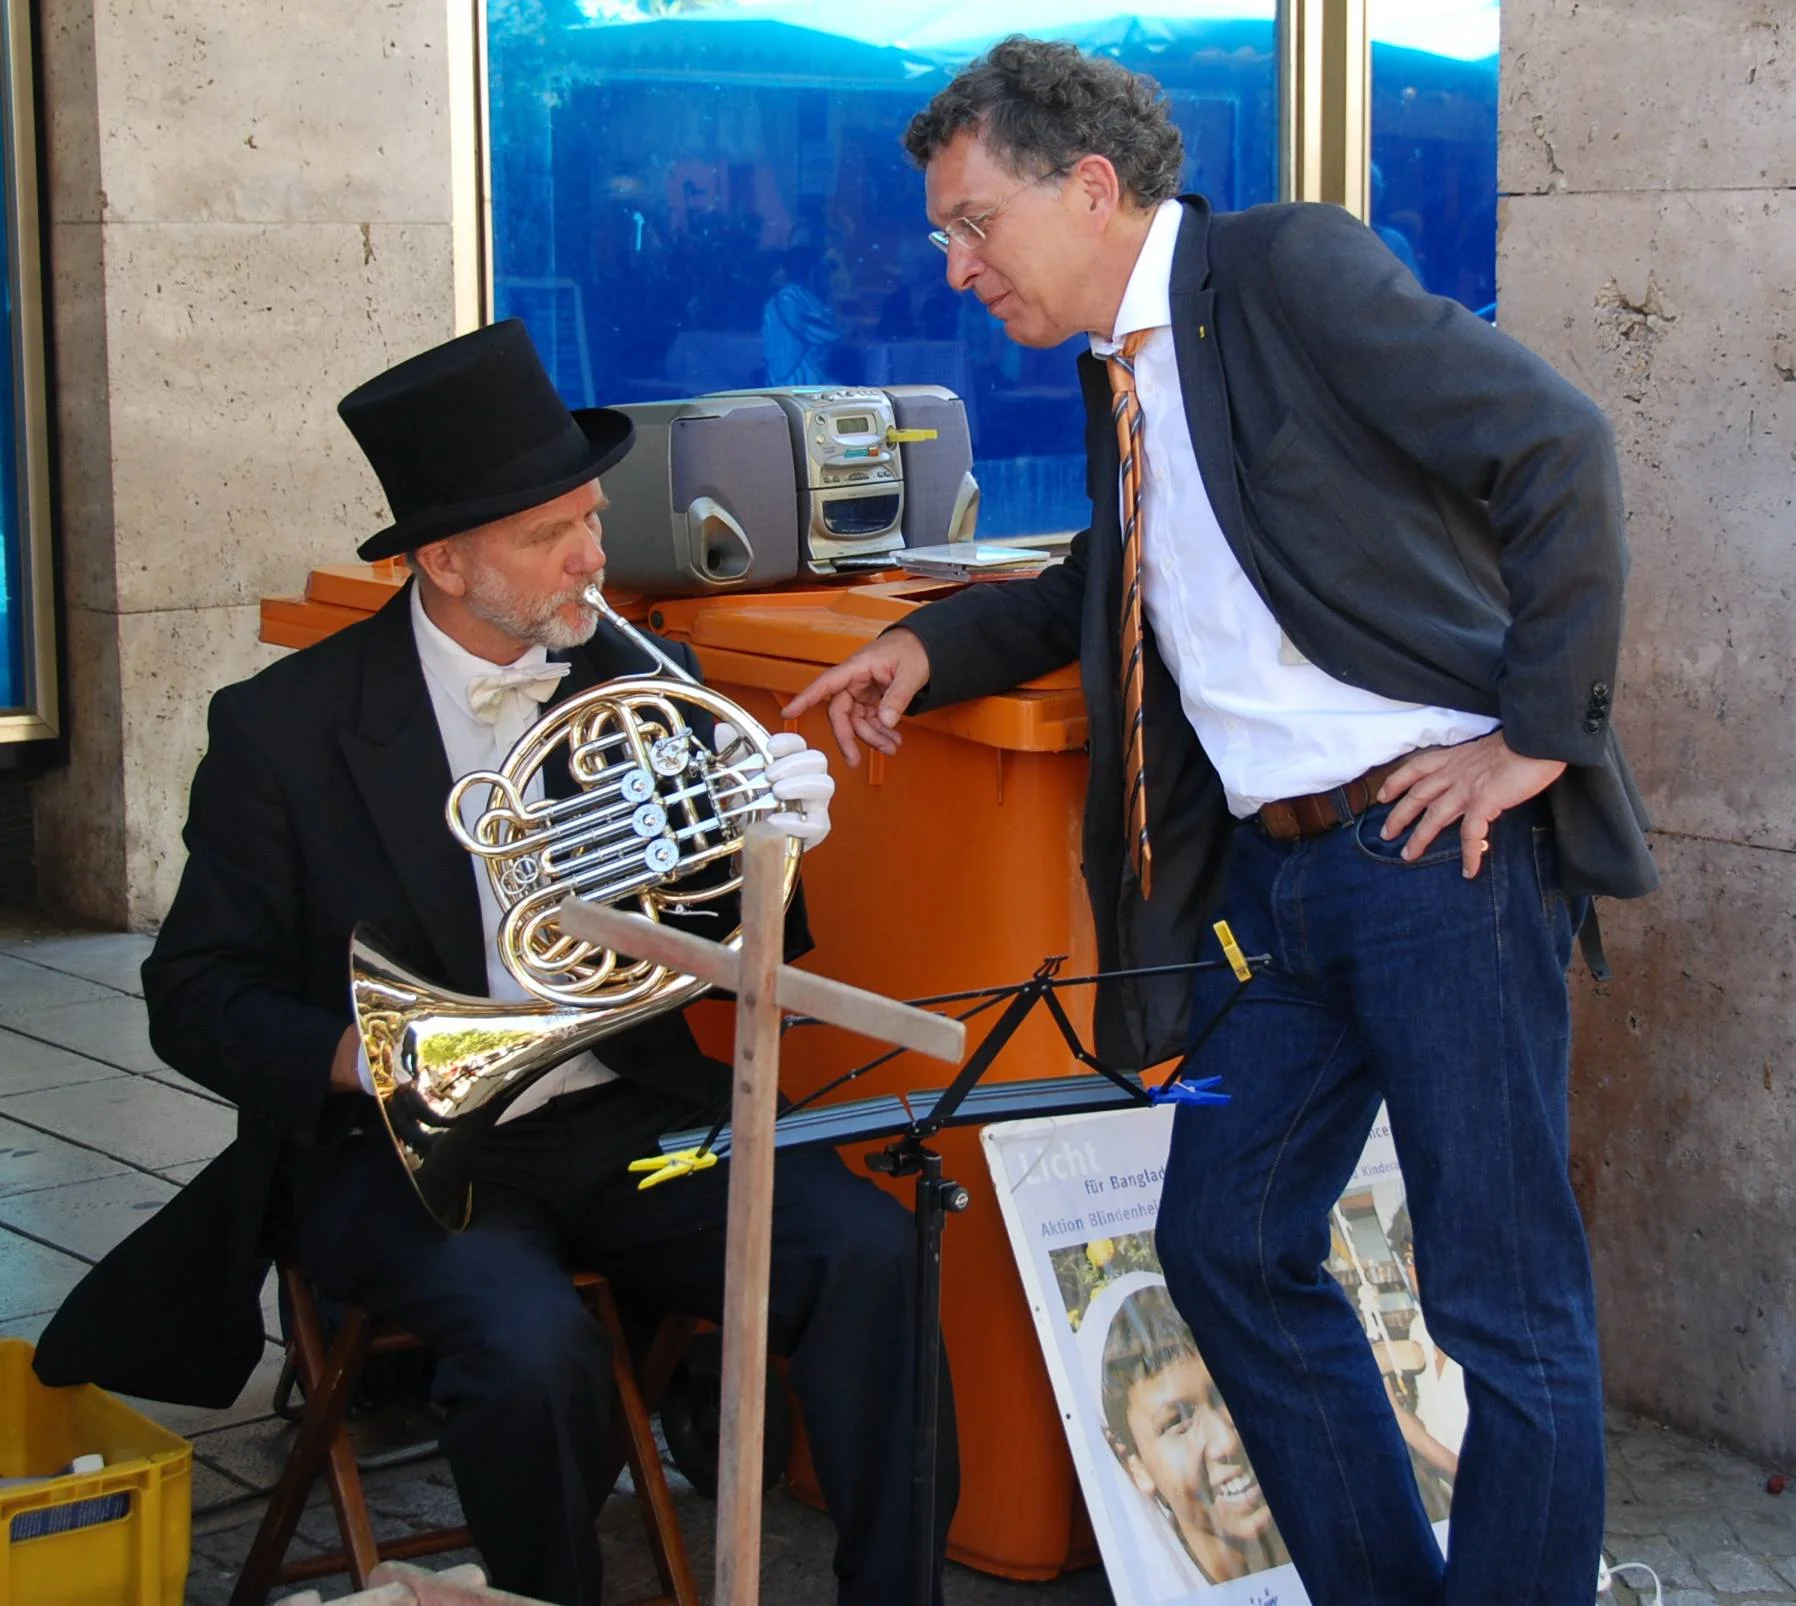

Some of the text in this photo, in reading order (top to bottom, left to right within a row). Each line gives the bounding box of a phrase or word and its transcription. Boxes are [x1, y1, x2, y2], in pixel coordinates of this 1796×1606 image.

[1018, 1140, 1102, 1184] Licht
[1084, 1178, 1104, 1195] für
[1041, 1217, 1085, 1237] Aktion
